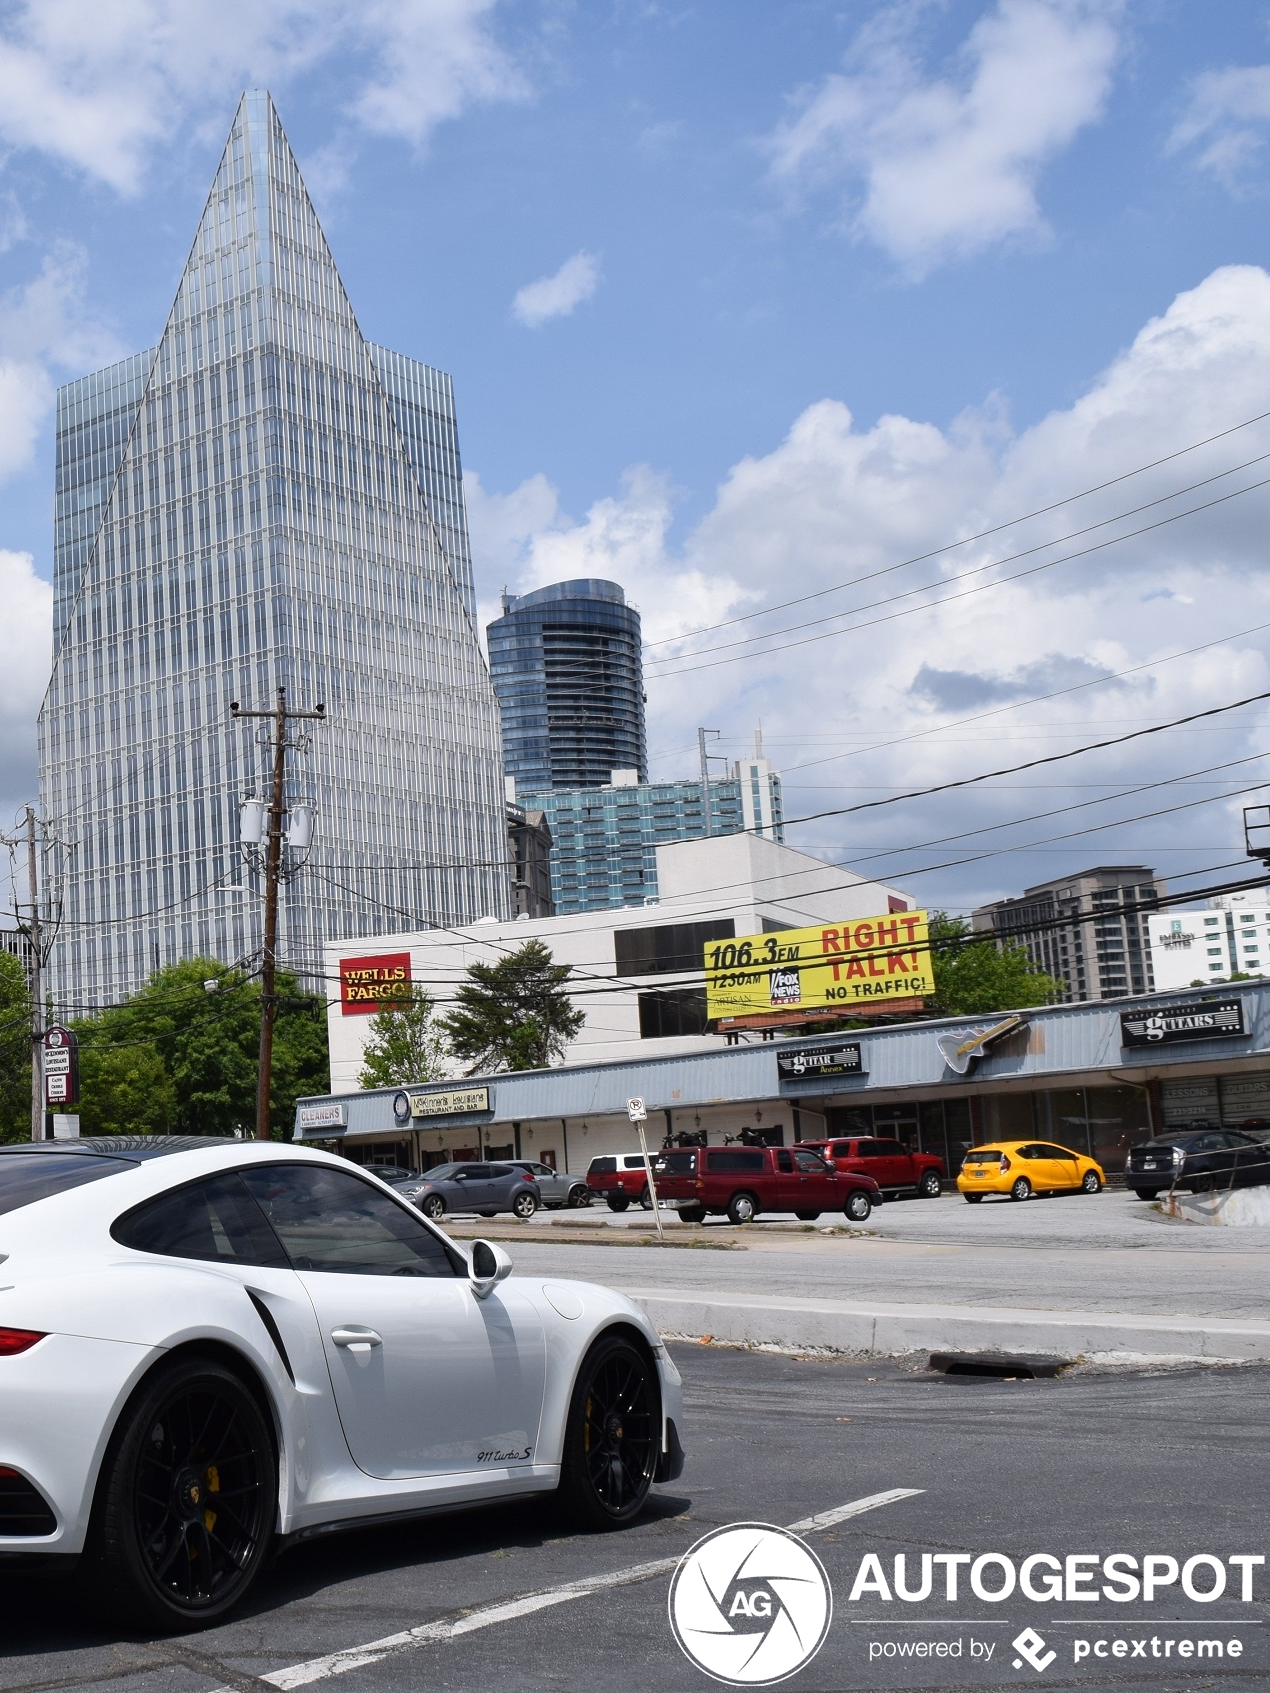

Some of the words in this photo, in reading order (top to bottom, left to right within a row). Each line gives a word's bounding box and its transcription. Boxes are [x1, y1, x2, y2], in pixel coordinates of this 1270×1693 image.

[822, 916, 920, 953] RIGHT
[1159, 933, 1194, 941] EMBASSY
[826, 947, 919, 981] TALK!
[344, 966, 405, 984] WELLS
[777, 973, 799, 986] FOX
[346, 983, 405, 1000] FARGO
[773, 985, 800, 998] NEWS
[825, 986, 847, 1000] NO
[852, 977, 926, 997] TRAFFIC!
[771, 997, 800, 1005] radio
[820, 1065, 843, 1073] Annex
[1167, 1087, 1209, 1098] LESSONS
[1227, 1082, 1268, 1094] GUITARS
[301, 1107, 340, 1121] CLEANERS
[419, 1107, 452, 1115] RESTAURANT
[477, 1451, 493, 1462] 911
[518, 1446, 533, 1460] S
